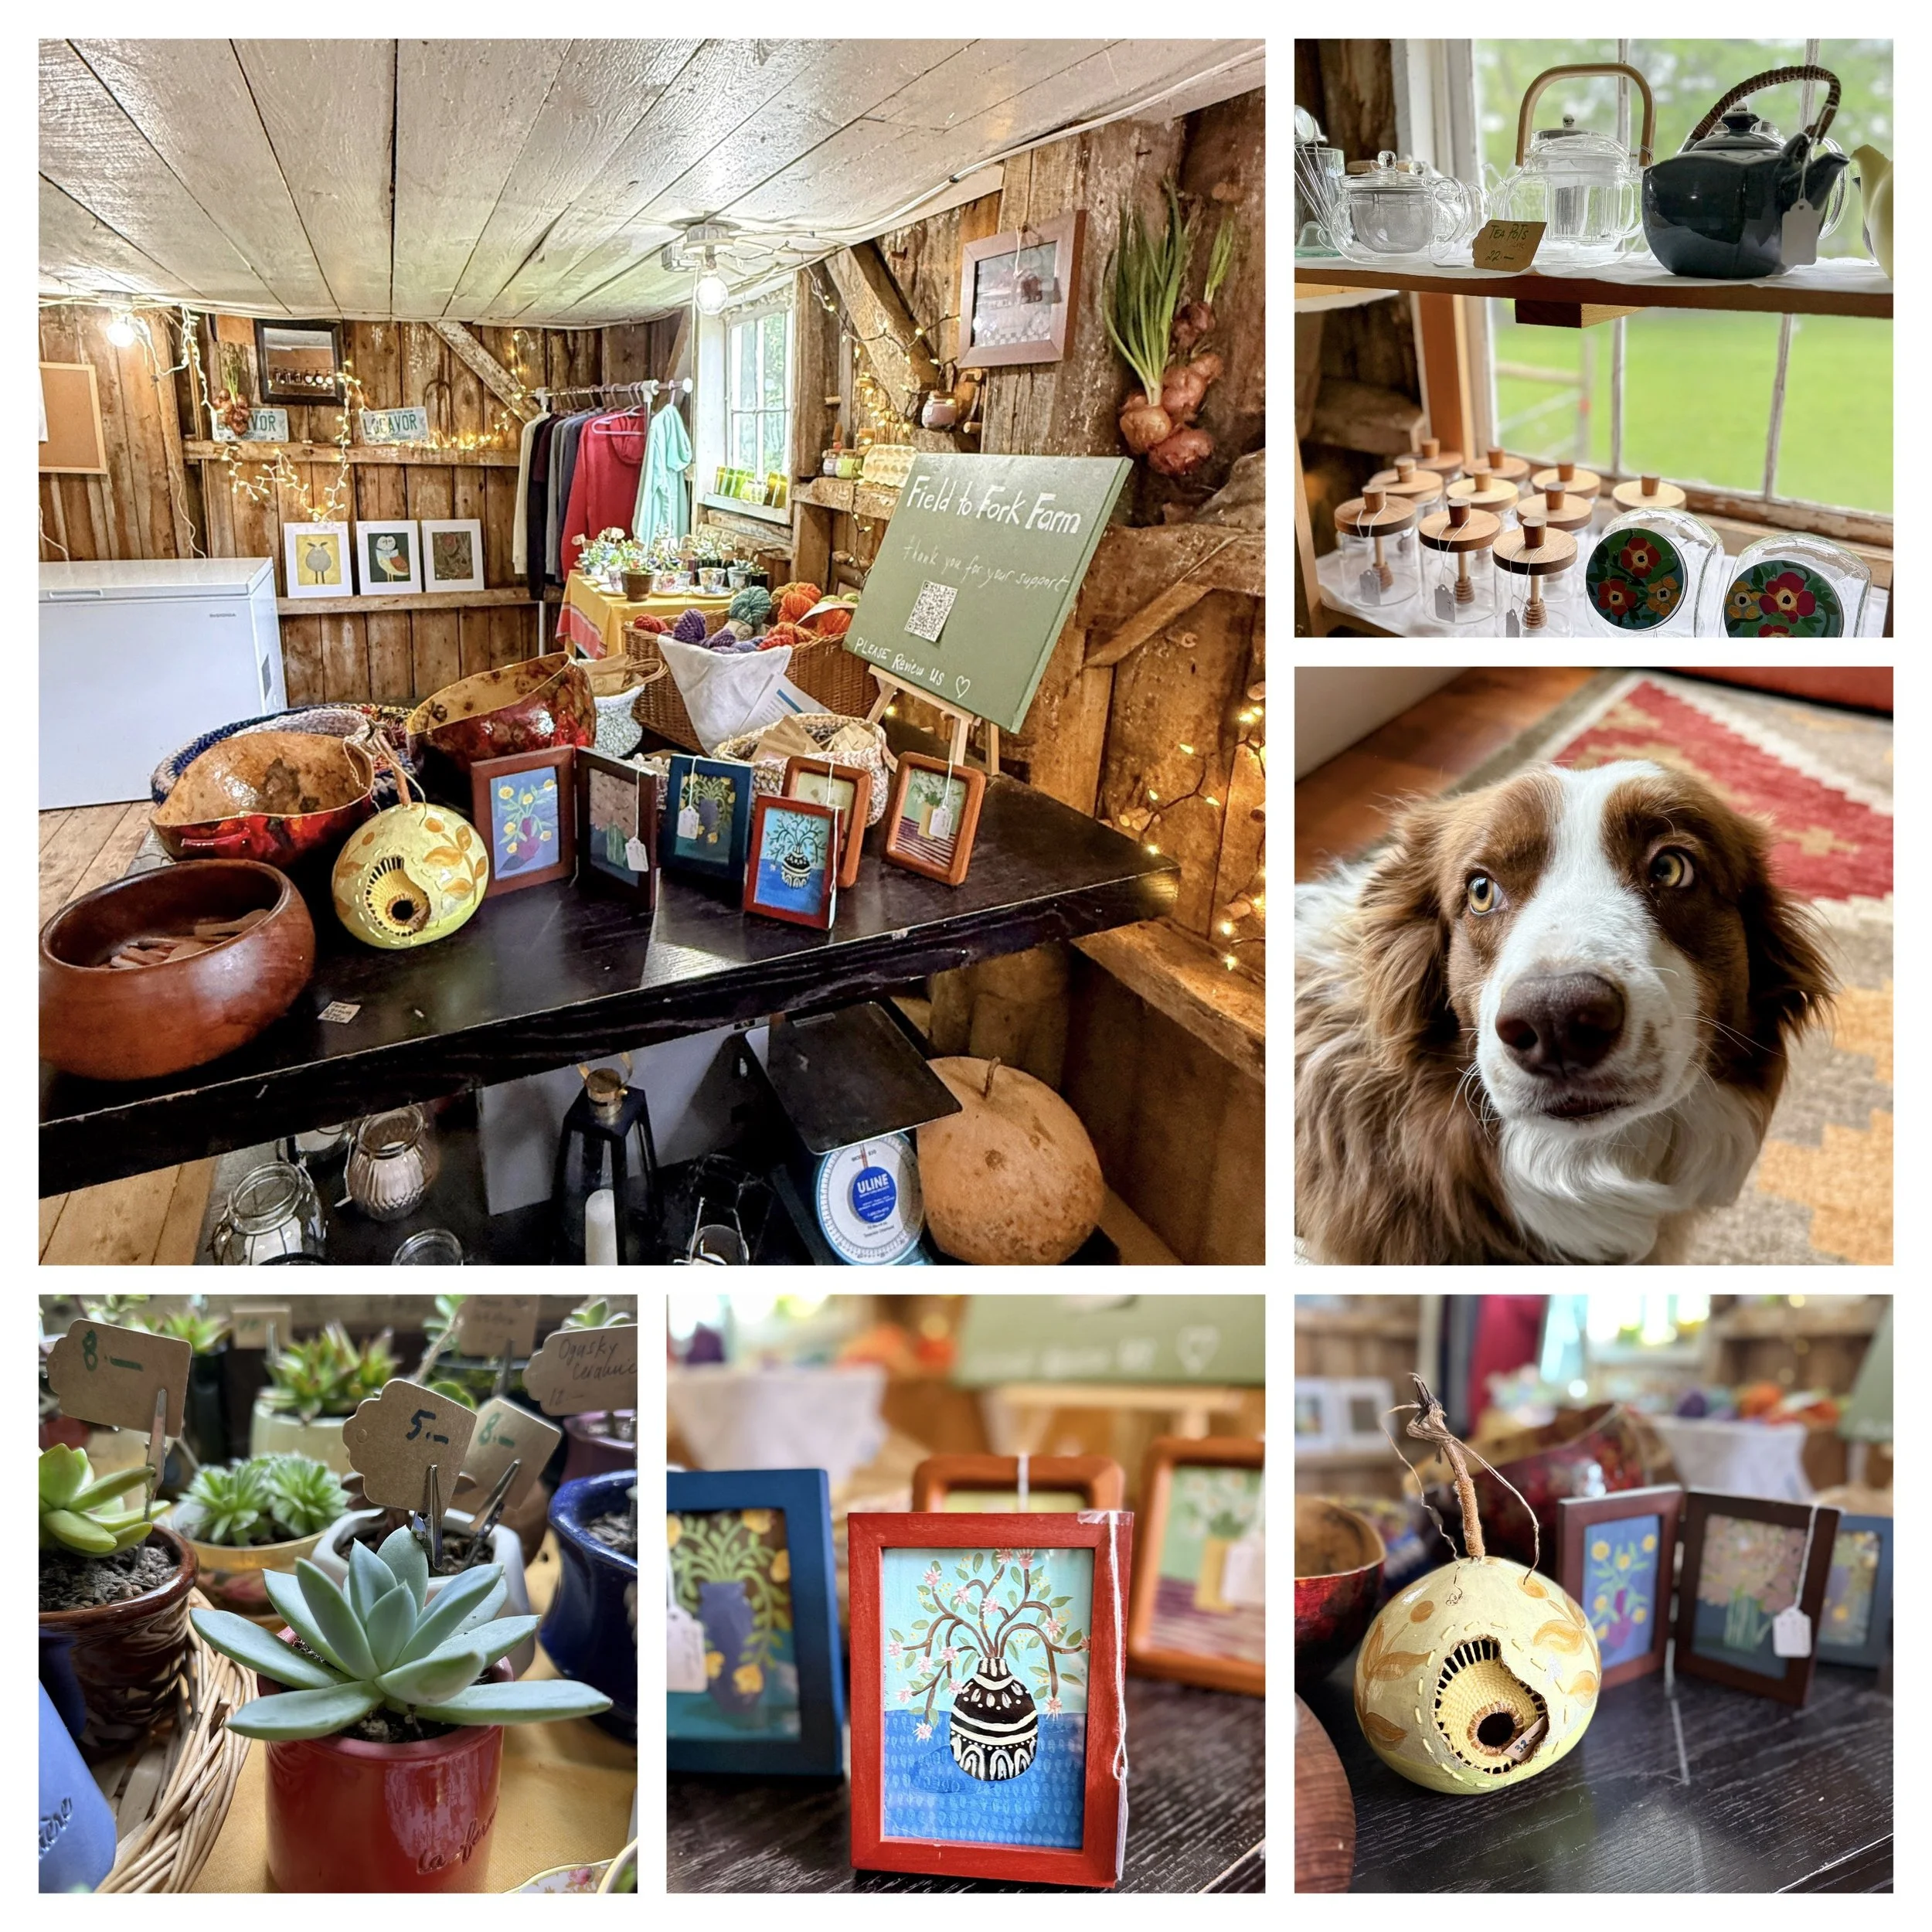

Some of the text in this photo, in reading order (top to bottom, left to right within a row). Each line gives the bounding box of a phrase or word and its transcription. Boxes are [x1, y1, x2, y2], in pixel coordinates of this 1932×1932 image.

[1488, 224, 1505, 240] TEA
[906, 475, 1082, 534] Field to Fork Farm
[941, 556, 962, 575] you
[961, 554, 983, 583] for
[978, 567, 1015, 589] your
[1015, 573, 1070, 593] support
[854, 637, 891, 659] PLEASE
[892, 653, 925, 677] Review
[857, 1173, 889, 1194] ULINE
